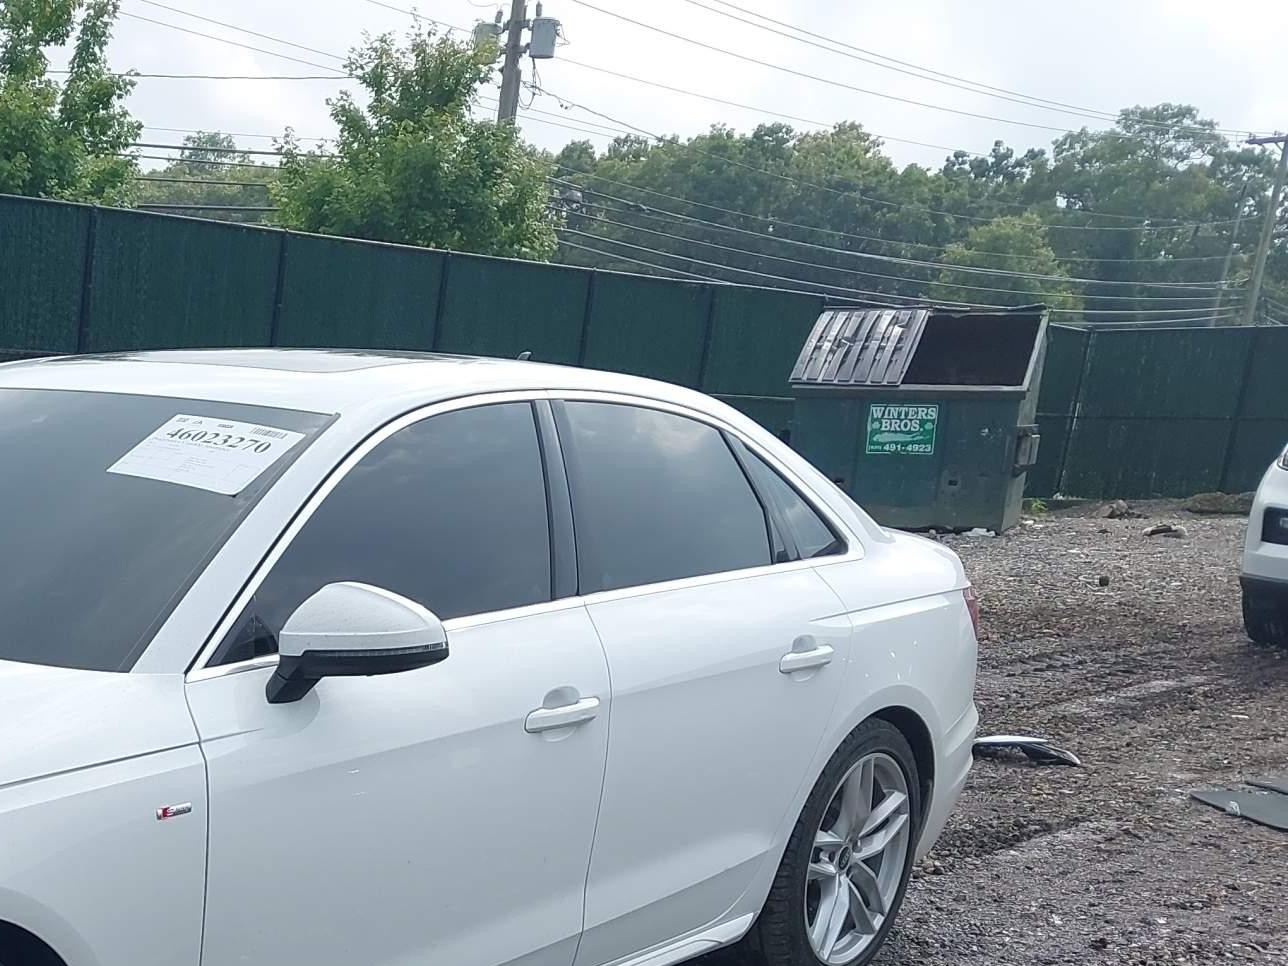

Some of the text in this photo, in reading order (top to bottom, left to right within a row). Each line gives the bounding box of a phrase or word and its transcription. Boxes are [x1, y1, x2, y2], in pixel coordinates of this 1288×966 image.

[872, 406, 936, 420] WINTERS
[880, 419, 924, 431] BROS.
[167, 427, 272, 454] 46023270
